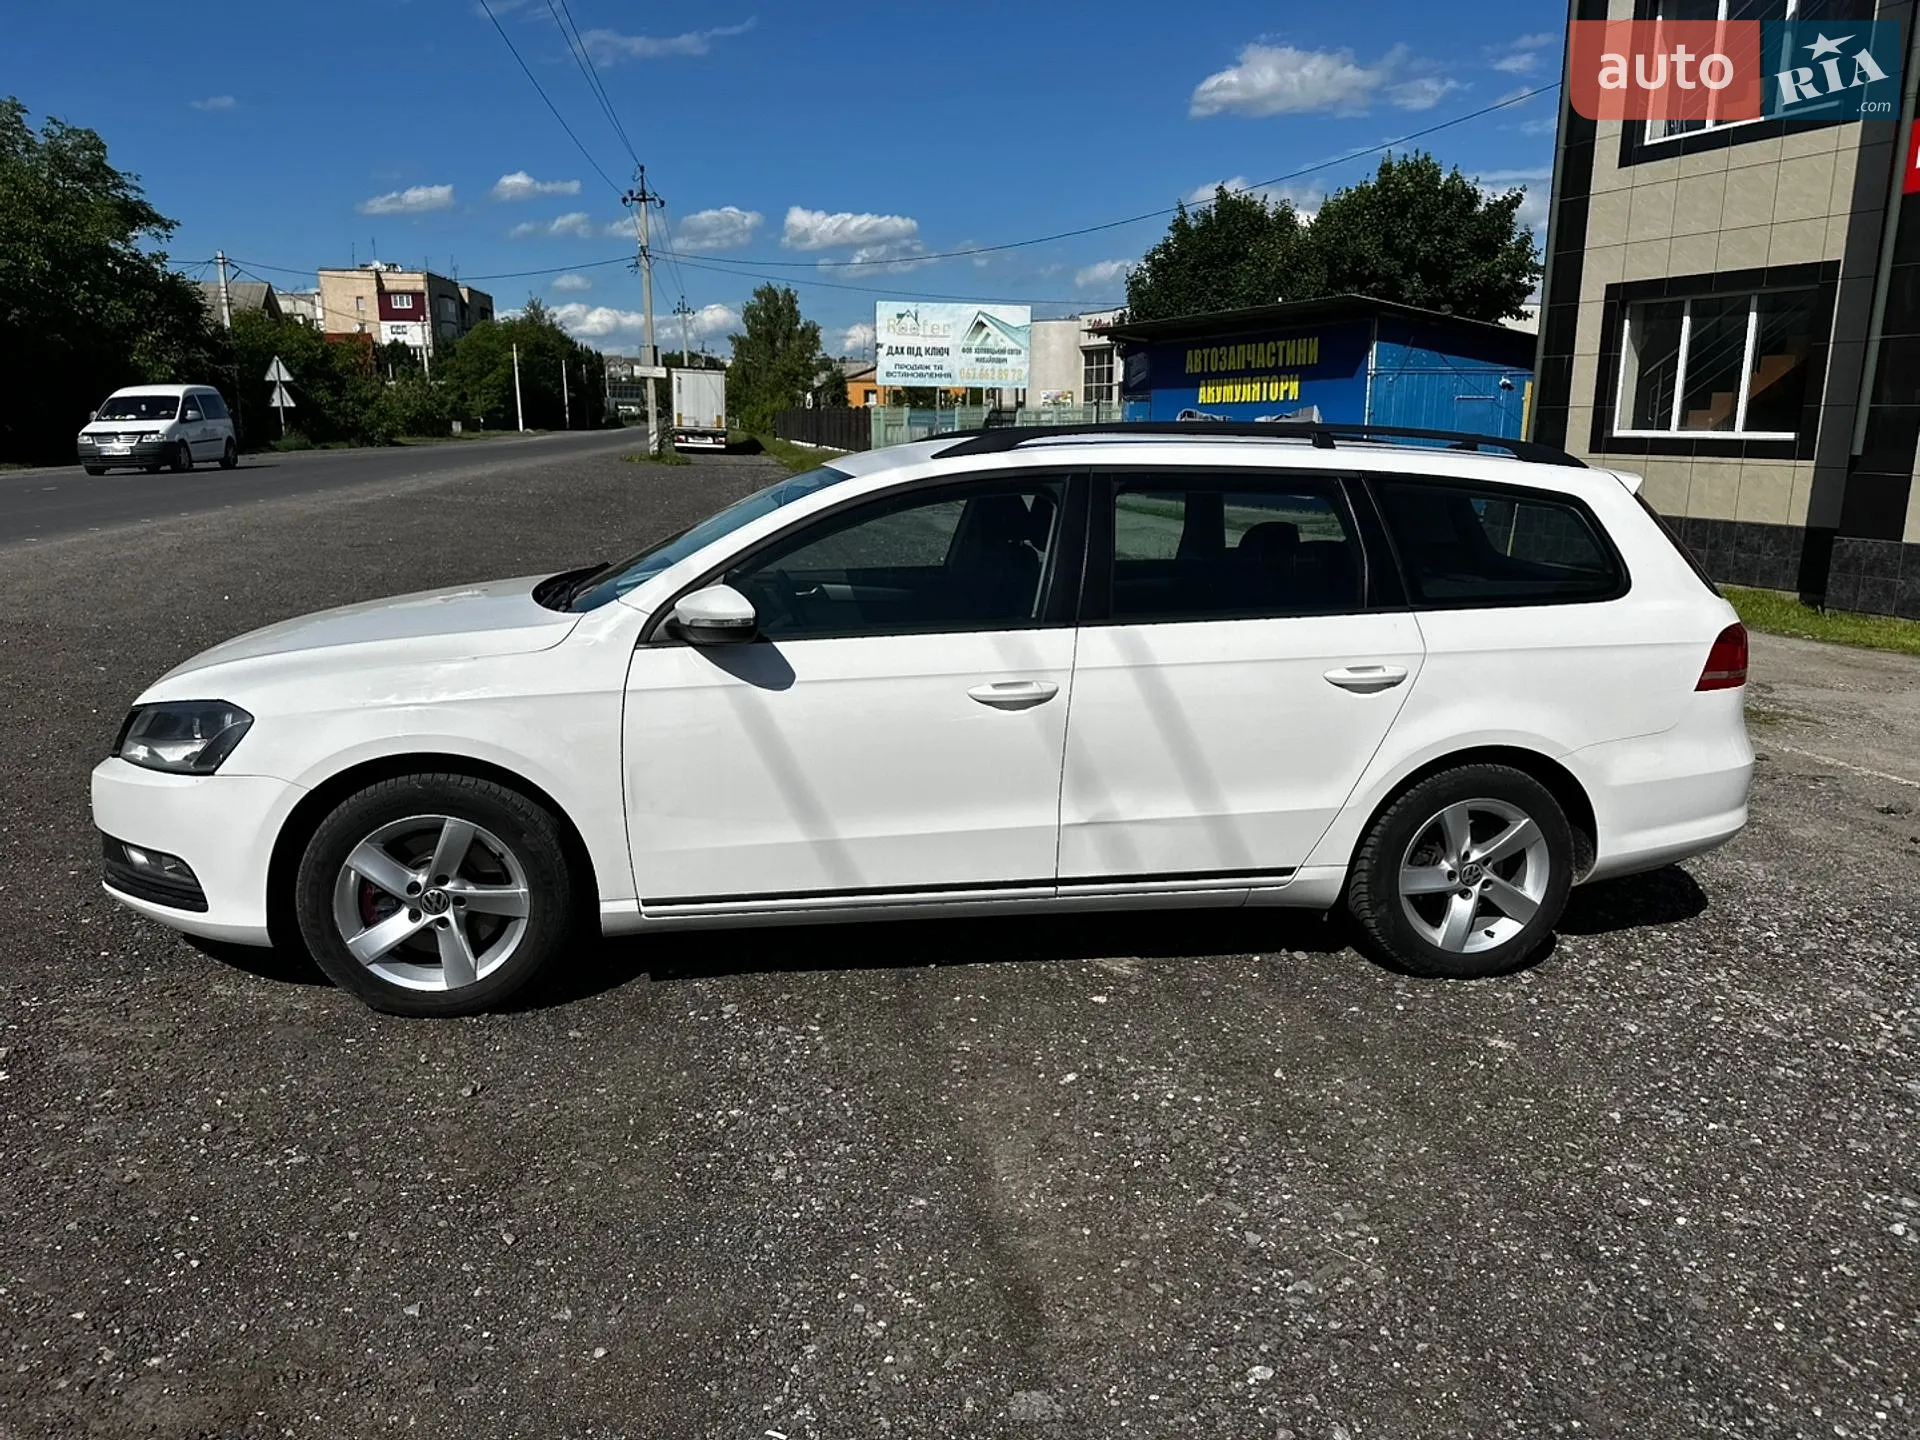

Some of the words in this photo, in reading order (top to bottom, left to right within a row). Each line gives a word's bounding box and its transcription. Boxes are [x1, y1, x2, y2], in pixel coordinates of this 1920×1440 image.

[886, 345, 905, 357] ДАХ
[906, 345, 923, 357] ПІД
[924, 346, 950, 357] КЛЮЧ
[1185, 336, 1319, 374] АВТОЗАПЧАСТИНИ
[1198, 374, 1300, 404] АКУМУЛЯТОРИ
